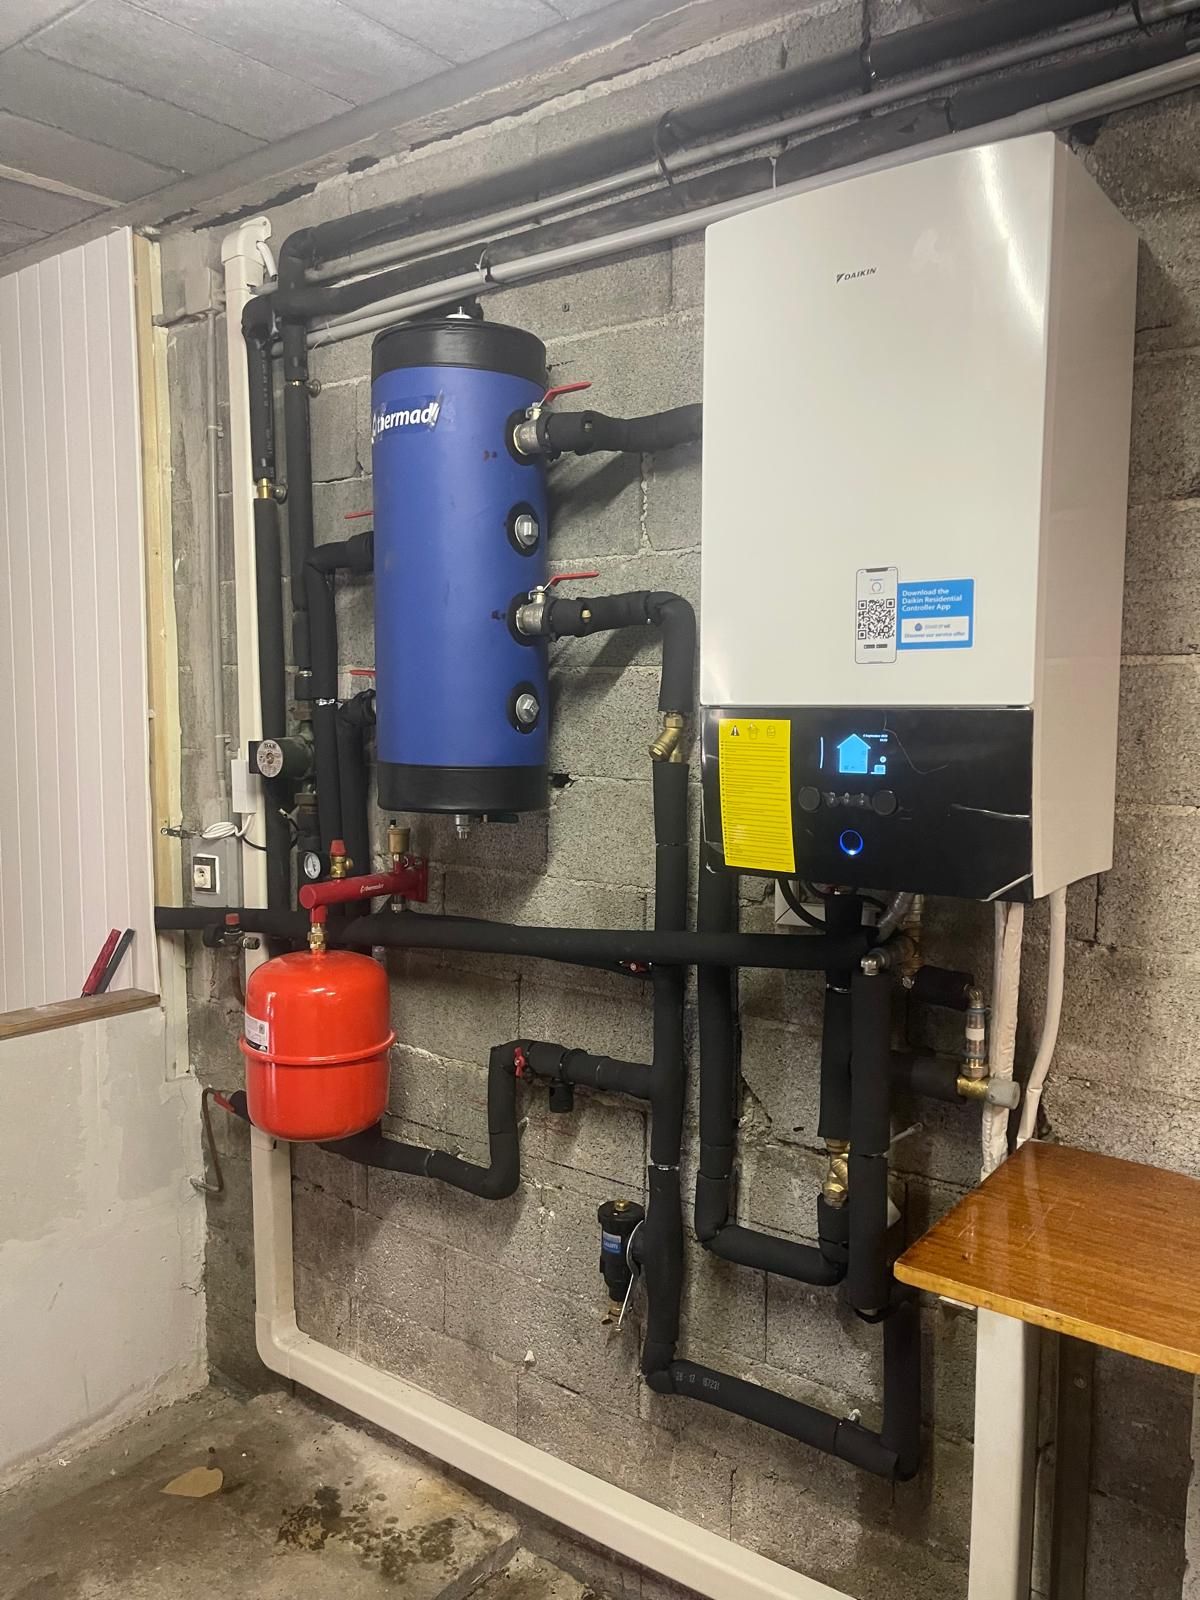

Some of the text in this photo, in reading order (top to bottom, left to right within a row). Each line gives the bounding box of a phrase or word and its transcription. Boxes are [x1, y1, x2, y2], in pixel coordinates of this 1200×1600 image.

[844, 267, 876, 281] DAIKIN
[902, 589, 936, 597] Download
[924, 594, 963, 603] Residential
[902, 604, 936, 612] Controller
